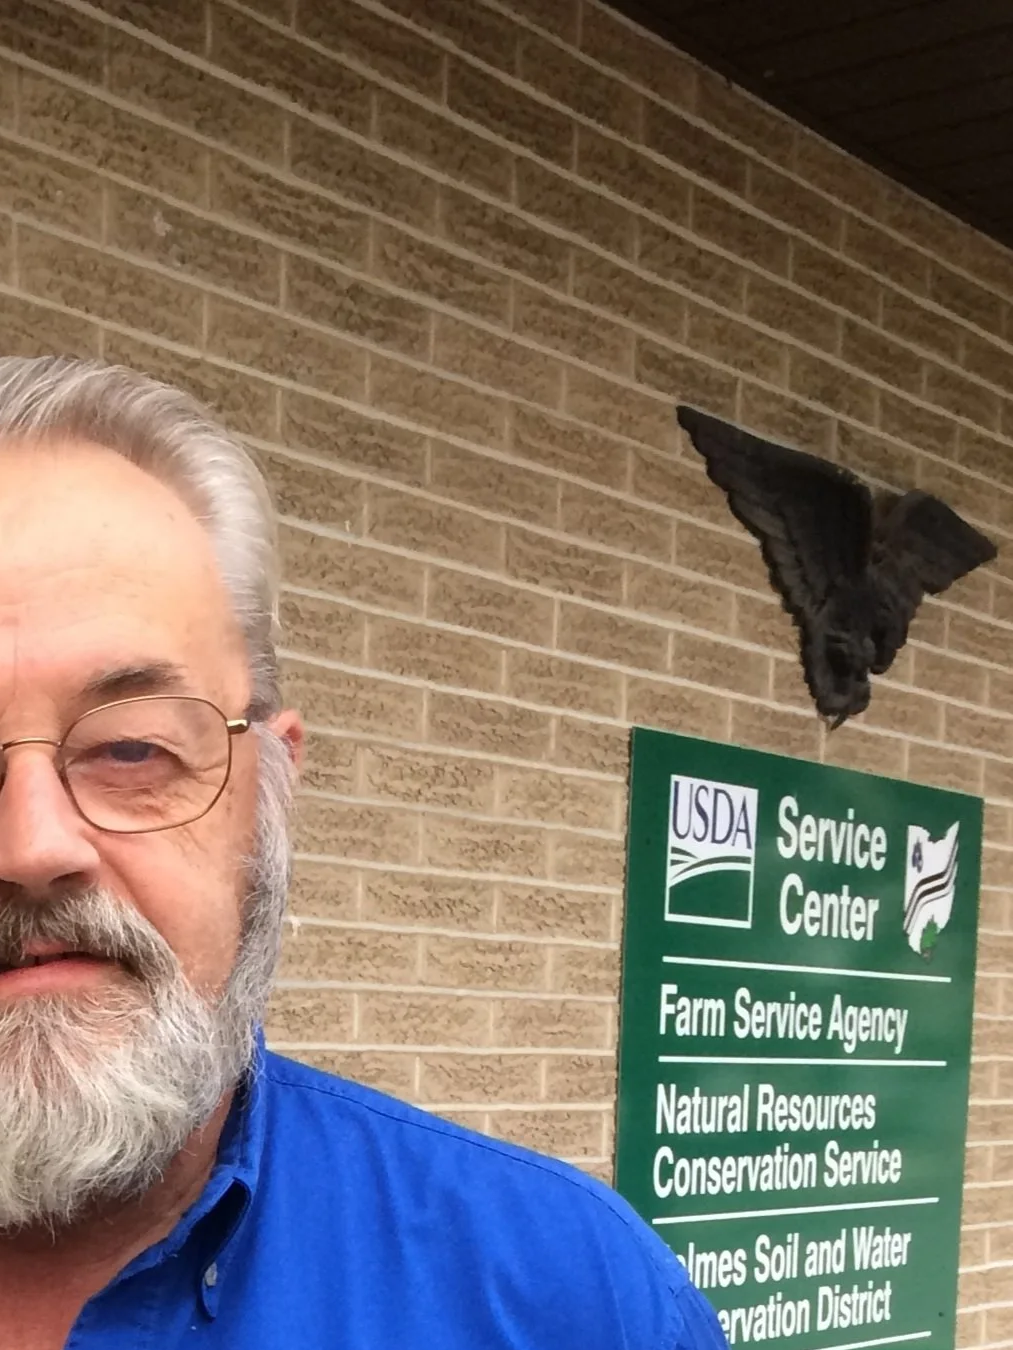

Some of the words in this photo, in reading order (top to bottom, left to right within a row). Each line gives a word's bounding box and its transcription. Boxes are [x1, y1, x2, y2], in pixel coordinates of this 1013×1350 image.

[672, 780, 753, 850] USDA
[776, 795, 888, 871] Service
[779, 872, 880, 942] Center
[659, 983, 726, 1037] Farm
[733, 986, 822, 1041] Service
[826, 993, 909, 1055] Agency
[655, 1083, 750, 1135] Natural
[756, 1083, 877, 1133] Resources
[653, 1142, 818, 1198] Conservation
[823, 1139, 903, 1189] Service
[753, 1232, 801, 1283] Soil
[804, 1228, 847, 1278] and
[852, 1225, 913, 1271] Water
[816, 1280, 893, 1332] District
